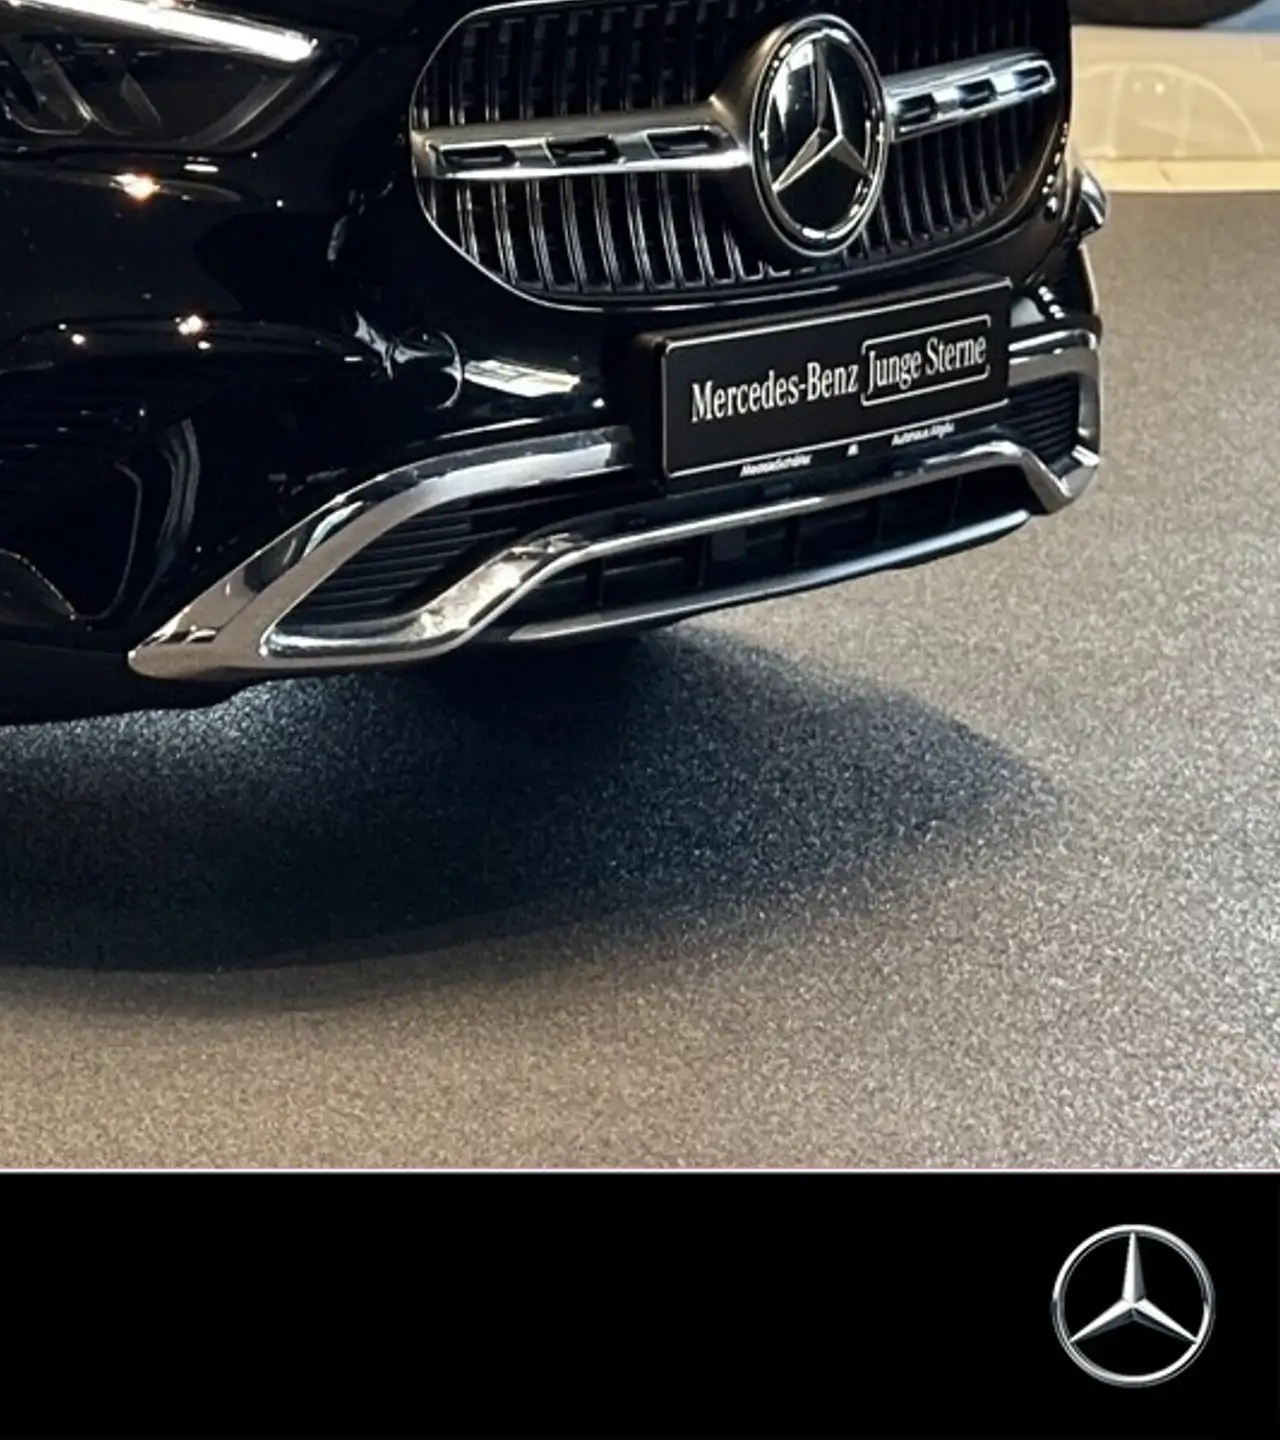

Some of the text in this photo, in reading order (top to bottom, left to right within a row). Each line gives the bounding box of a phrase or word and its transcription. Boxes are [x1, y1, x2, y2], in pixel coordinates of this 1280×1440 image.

[691, 335, 987, 423] Mercedes-Benz Junge Sterne
